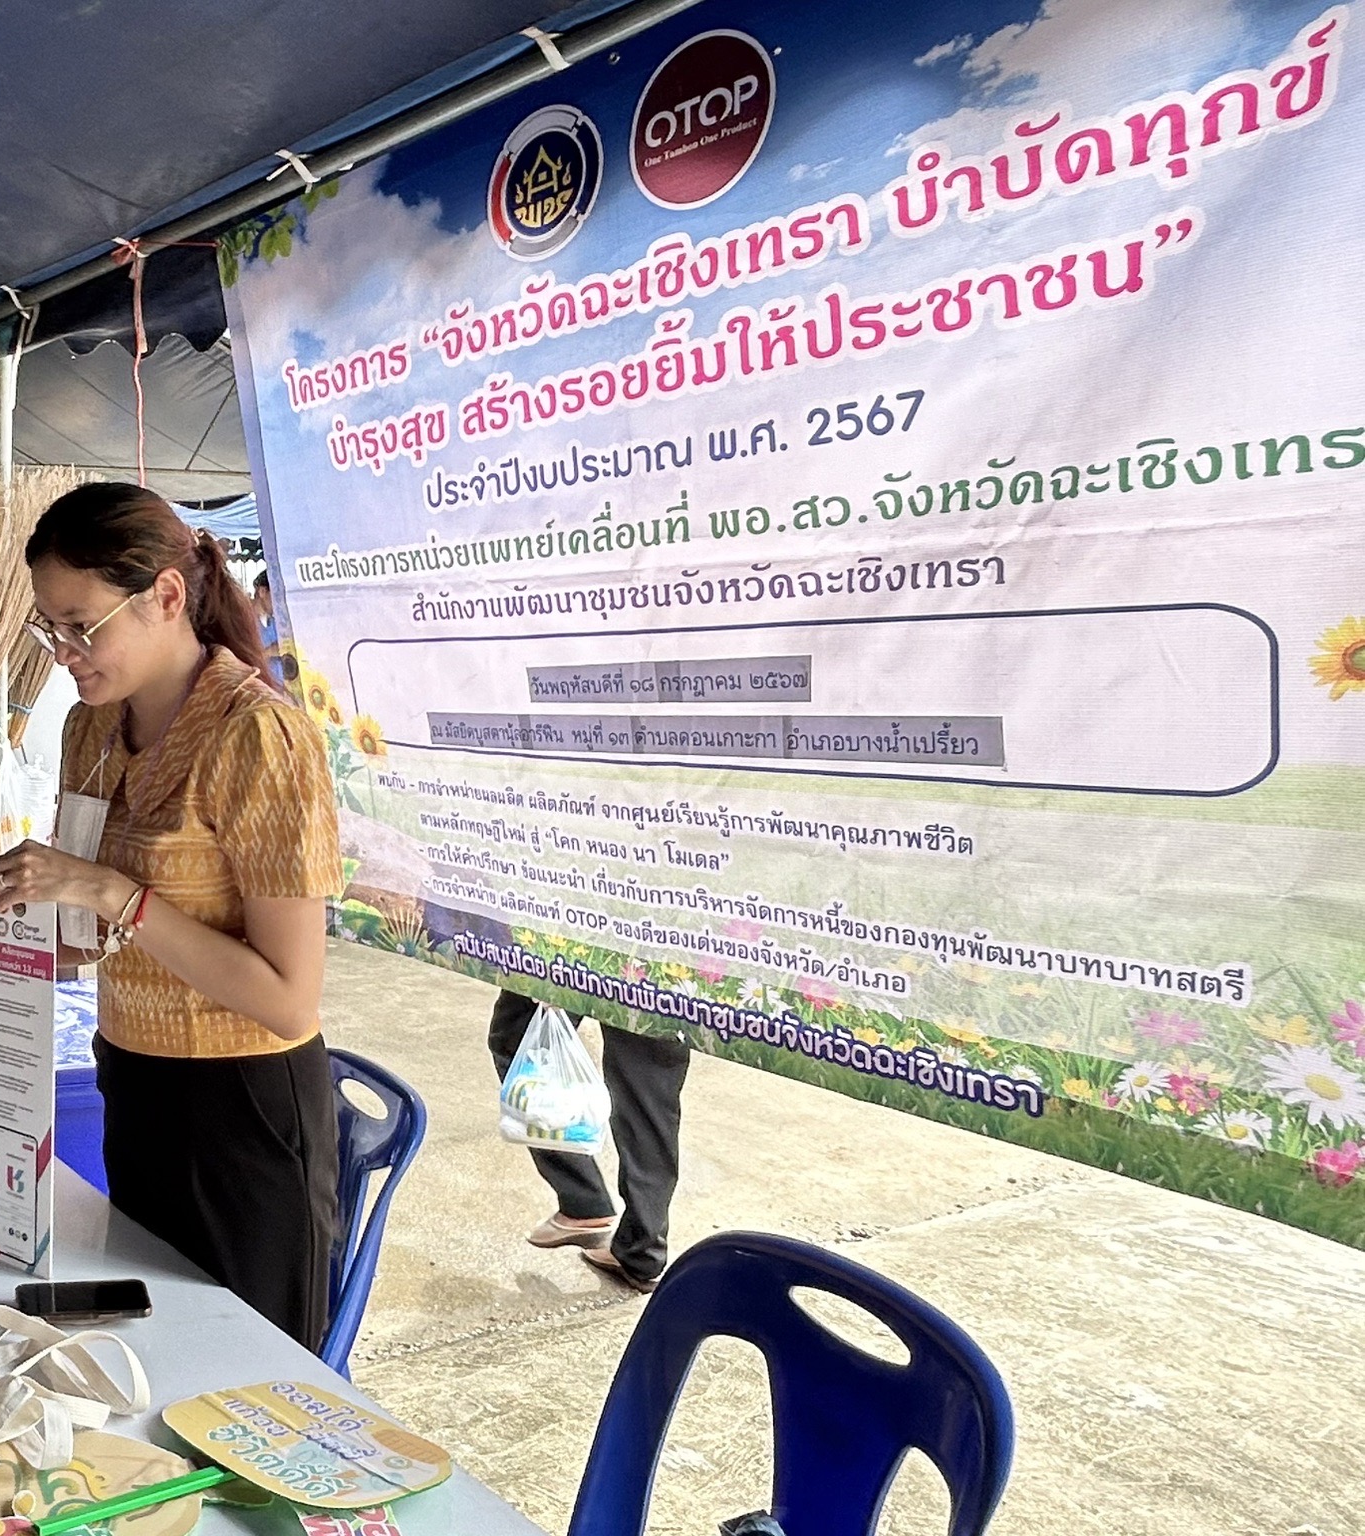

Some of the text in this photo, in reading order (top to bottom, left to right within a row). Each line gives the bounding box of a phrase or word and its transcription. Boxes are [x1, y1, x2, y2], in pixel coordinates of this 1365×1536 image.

[645, 75, 758, 148] OTOP
[645, 118, 757, 168] One Tambon One Product
[285, 19, 1338, 408] โครงการ “จังหวัดฉะเชิงเทรา บำบัดทุกข์
[329, 217, 1195, 473] บำรุงสุข สร้างรอยยิ้มให้ประชาชน”
[425, 389, 925, 509] ประจำปีงบประมาณ พ.ศ. 2567
[298, 490, 691, 583] และโครงการหน่วยแพทย์เคลื่อนที่
[412, 555, 1006, 622] สำนักงานพัฒนาชุมชนจังหวัดฉะเชิงเทรา
[531, 663, 810, 698] วันพฤหัสบดีที่ ๑๘ กรกฎาคม ๒๕๖๗
[431, 724, 443, 738] ณ
[571, 720, 604, 751] หมู่ที่
[608, 733, 631, 747] ๑๓
[635, 725, 776, 748] ตำบลดอนเกาะกา
[786, 721, 979, 756] อำเภอบางน้ำเปรี้ยว
[378, 770, 406, 790] พบกับ
[418, 778, 524, 808] การจำหน่ายผลผลิต
[529, 791, 596, 817] ผลิตภัณฑ์
[601, 799, 974, 855] จากศูนย์เรียนรู้การพัฒนาคุณภาพชีวิต
[421, 811, 526, 843] ตามหลักทฤษฎีใหม่
[530, 824, 541, 852] สู่
[586, 834, 627, 860] หนอง
[633, 844, 656, 864] นา
[663, 840, 730, 871] โมเดล”
[427, 842, 517, 877] การให้คำปรึกษา
[521, 859, 586, 890] ข้อแนะนำ
[591, 867, 1246, 1001] เกี่ยวกับการบริหารจัดการหนี้ของกองทุนพัฒนาบทบาทสตรี
[432, 873, 497, 905] การจำหน่าย
[566, 907, 608, 931] OTOP
[612, 920, 907, 993] ของดีของเด่นของจังหวัด/อำเภอ
[453, 935, 1043, 1115] สนับสนุนโดย สำนักงานพัฒนาชุมชนจังหวัดฉะเชิงเทรา
[271, 1382, 375, 1433] ออมได้
